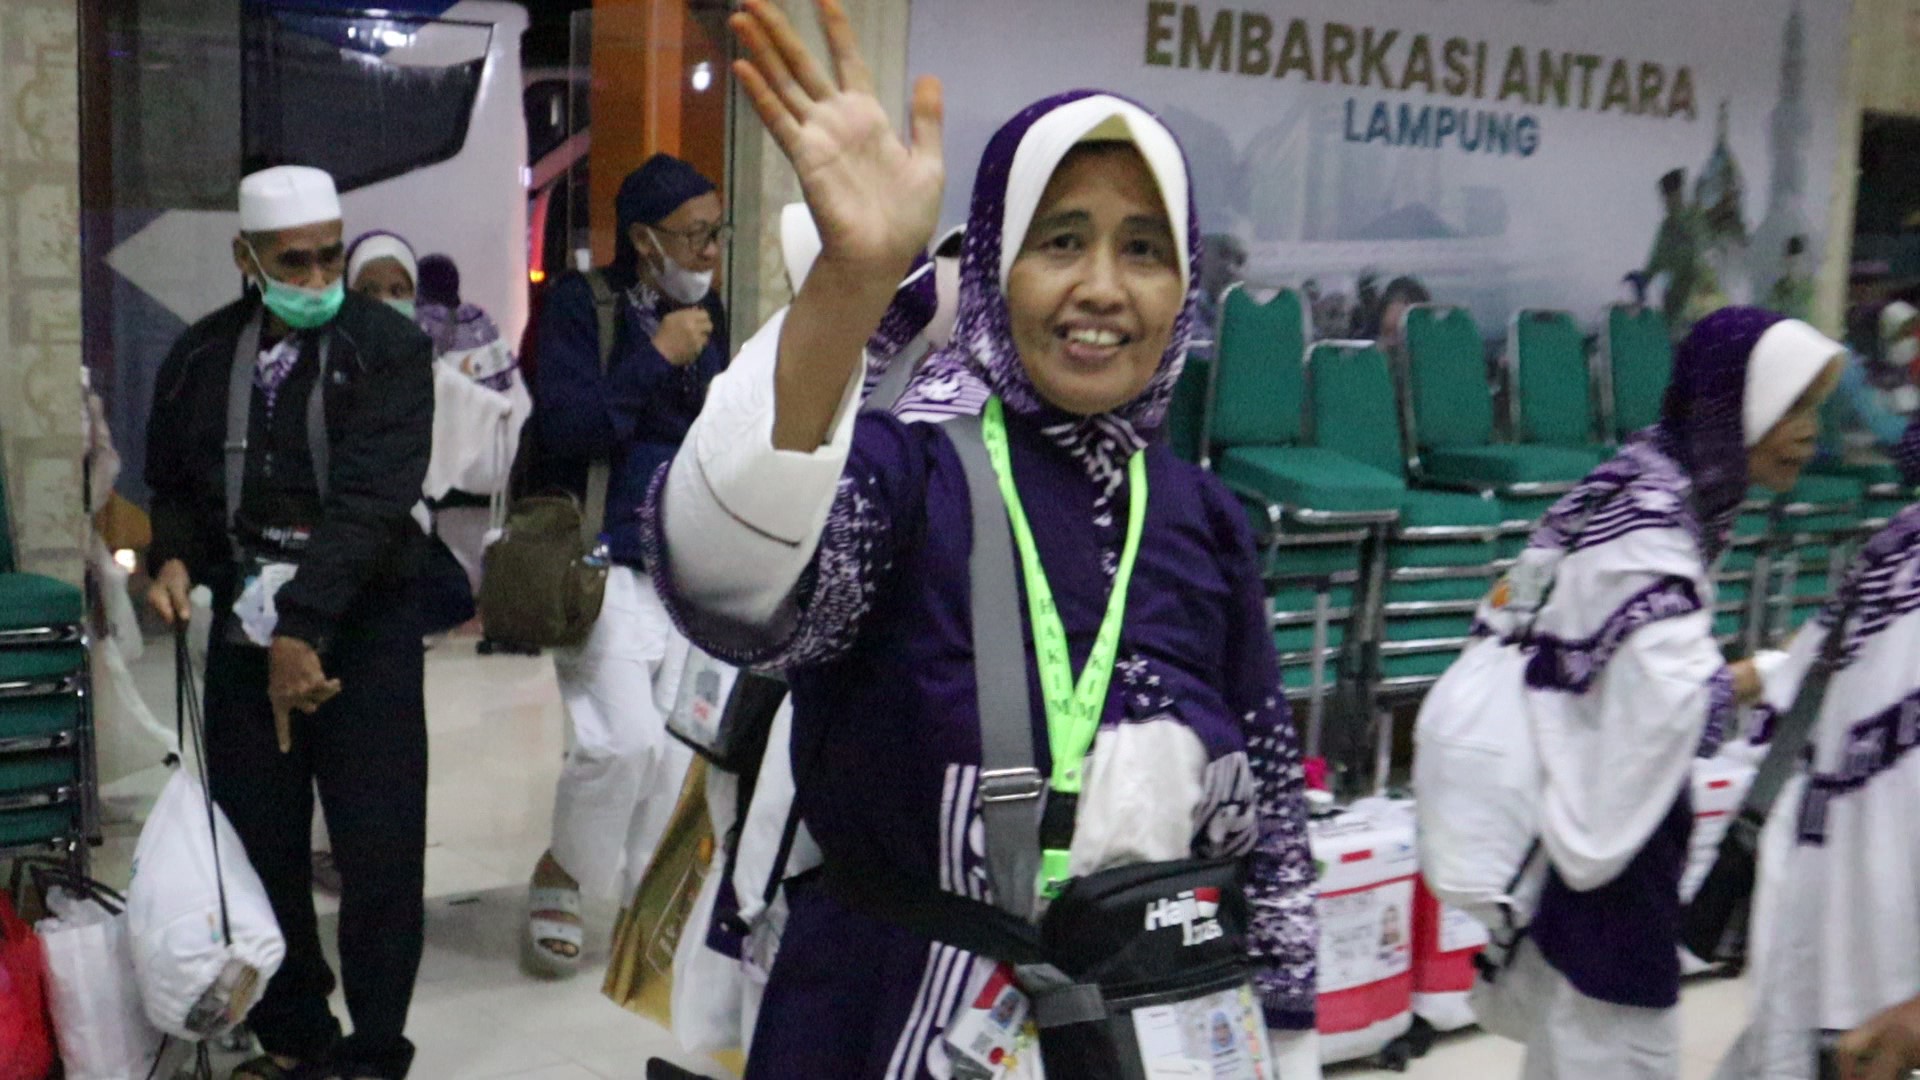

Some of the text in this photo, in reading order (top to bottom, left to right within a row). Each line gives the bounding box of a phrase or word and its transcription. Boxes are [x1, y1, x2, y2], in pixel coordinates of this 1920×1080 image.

[1144, 0, 1698, 121] EMBARKASI ANTARA
[1344, 99, 1539, 157] LAMPUNG
[1039, 597, 1070, 716] HAKIM
